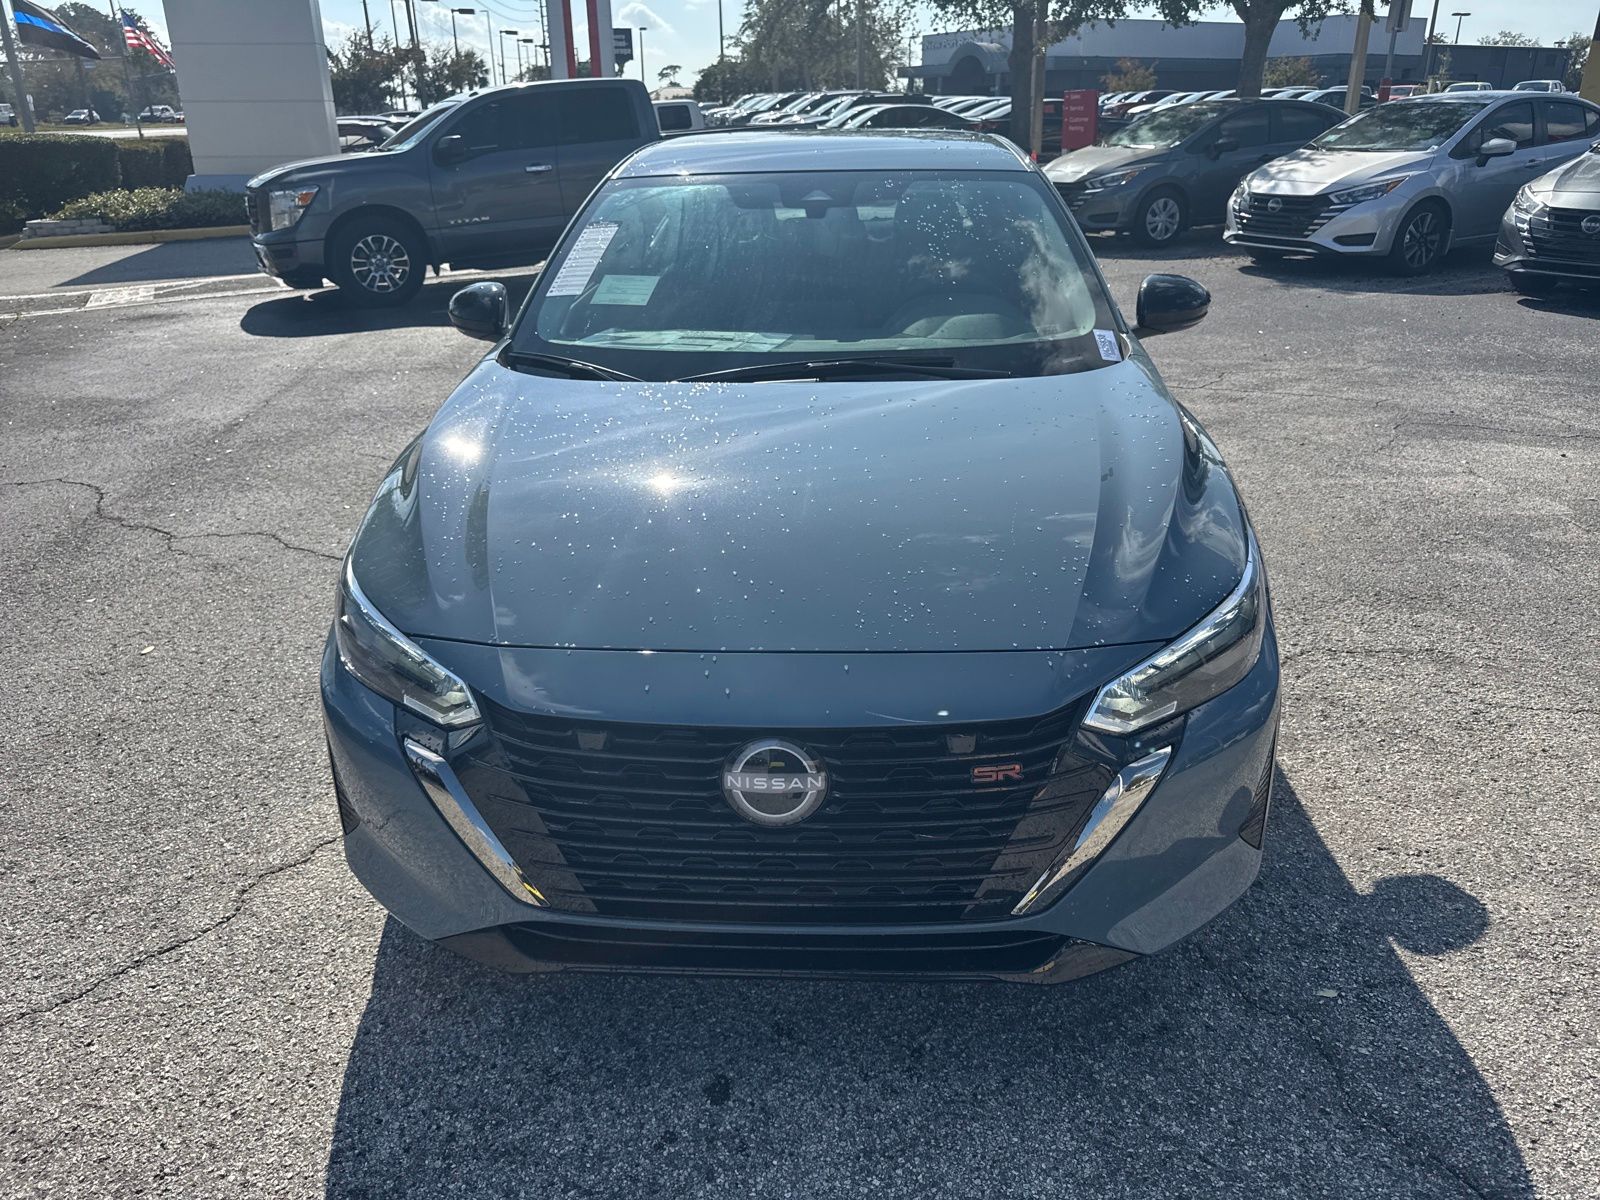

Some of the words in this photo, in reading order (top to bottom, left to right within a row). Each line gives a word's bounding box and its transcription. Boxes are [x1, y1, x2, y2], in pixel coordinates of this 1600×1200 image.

[449, 216, 490, 225] TITAN
[973, 764, 1023, 781] SR
[727, 775, 821, 790] NISSAN
